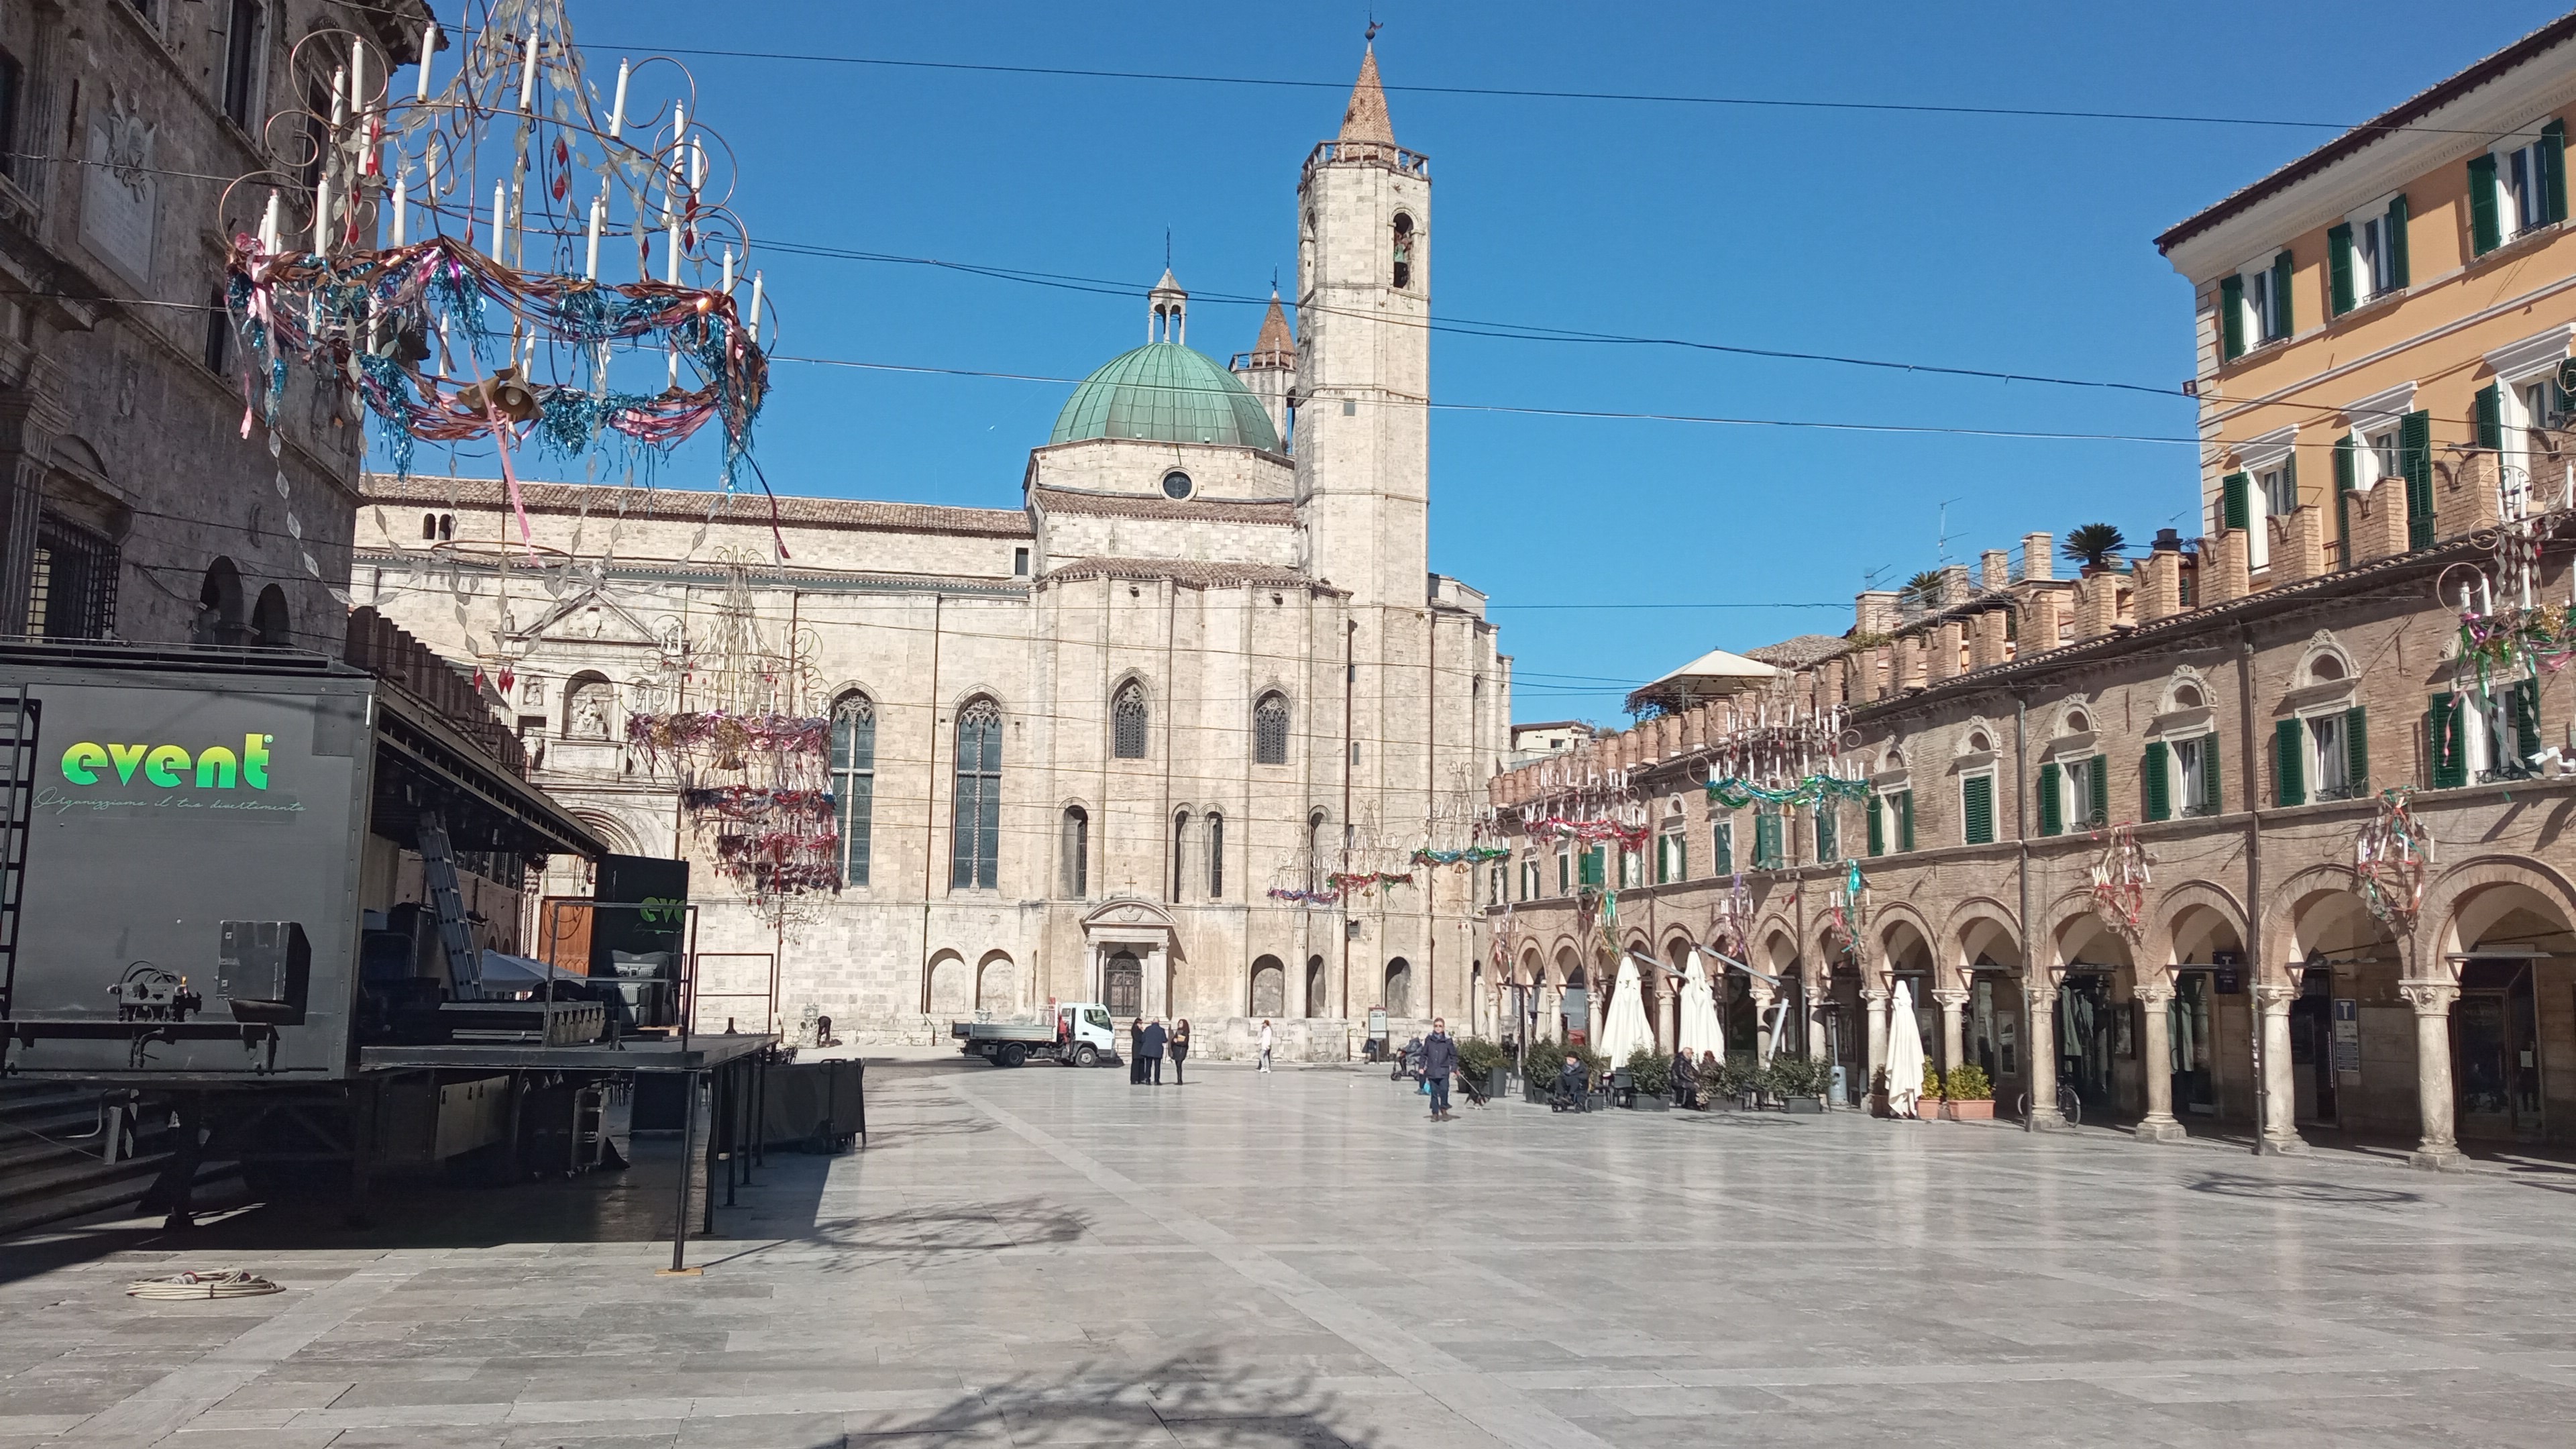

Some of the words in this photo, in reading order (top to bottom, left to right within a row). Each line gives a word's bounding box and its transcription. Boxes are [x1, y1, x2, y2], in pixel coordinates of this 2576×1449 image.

[60, 733, 270, 790] event
[154, 796, 173, 807] il
[2340, 1002, 2351, 1020] T
